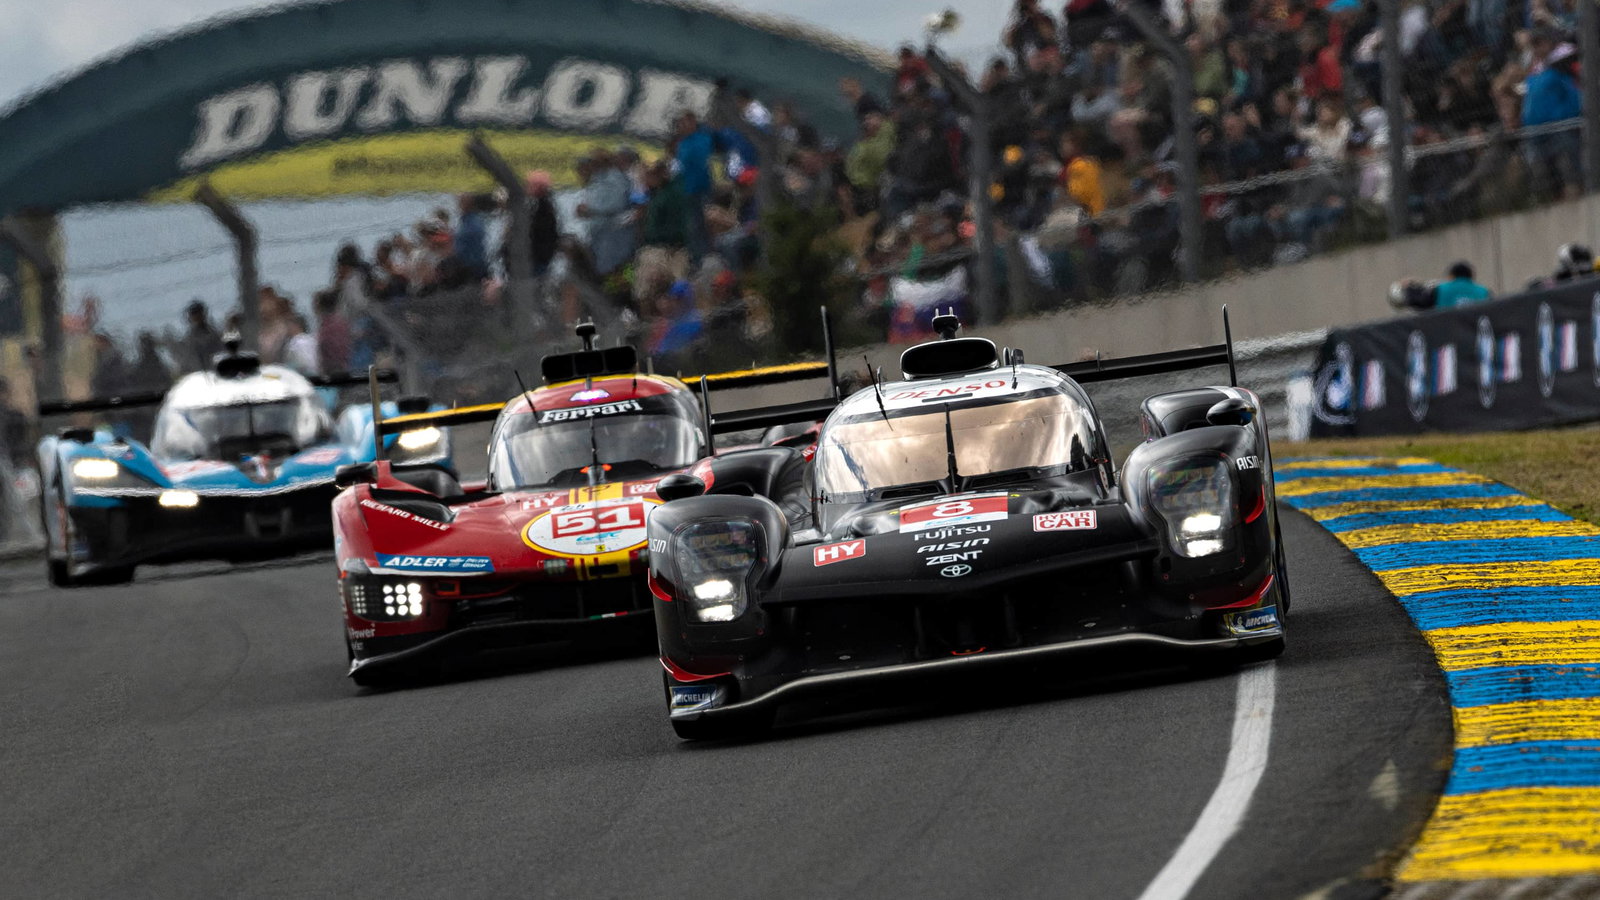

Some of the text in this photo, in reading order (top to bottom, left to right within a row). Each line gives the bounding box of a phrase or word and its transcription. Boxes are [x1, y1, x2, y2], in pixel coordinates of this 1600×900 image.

[179, 54, 717, 171] DUNLOP
[889, 380, 1006, 400] DENSO
[538, 399, 643, 424] Ferrari
[522, 496, 560, 511] HY
[932, 501, 974, 517] 8
[360, 499, 450, 531] RICHARD MILLE
[557, 506, 641, 535] 51
[1039, 512, 1090, 520] HYPER
[1039, 517, 1091, 529] CAR
[914, 525, 991, 541] FUJITSU
[817, 541, 862, 562] HY
[917, 538, 990, 553] AISIN
[384, 556, 447, 567] ADLER
[926, 550, 983, 566] ZENT
